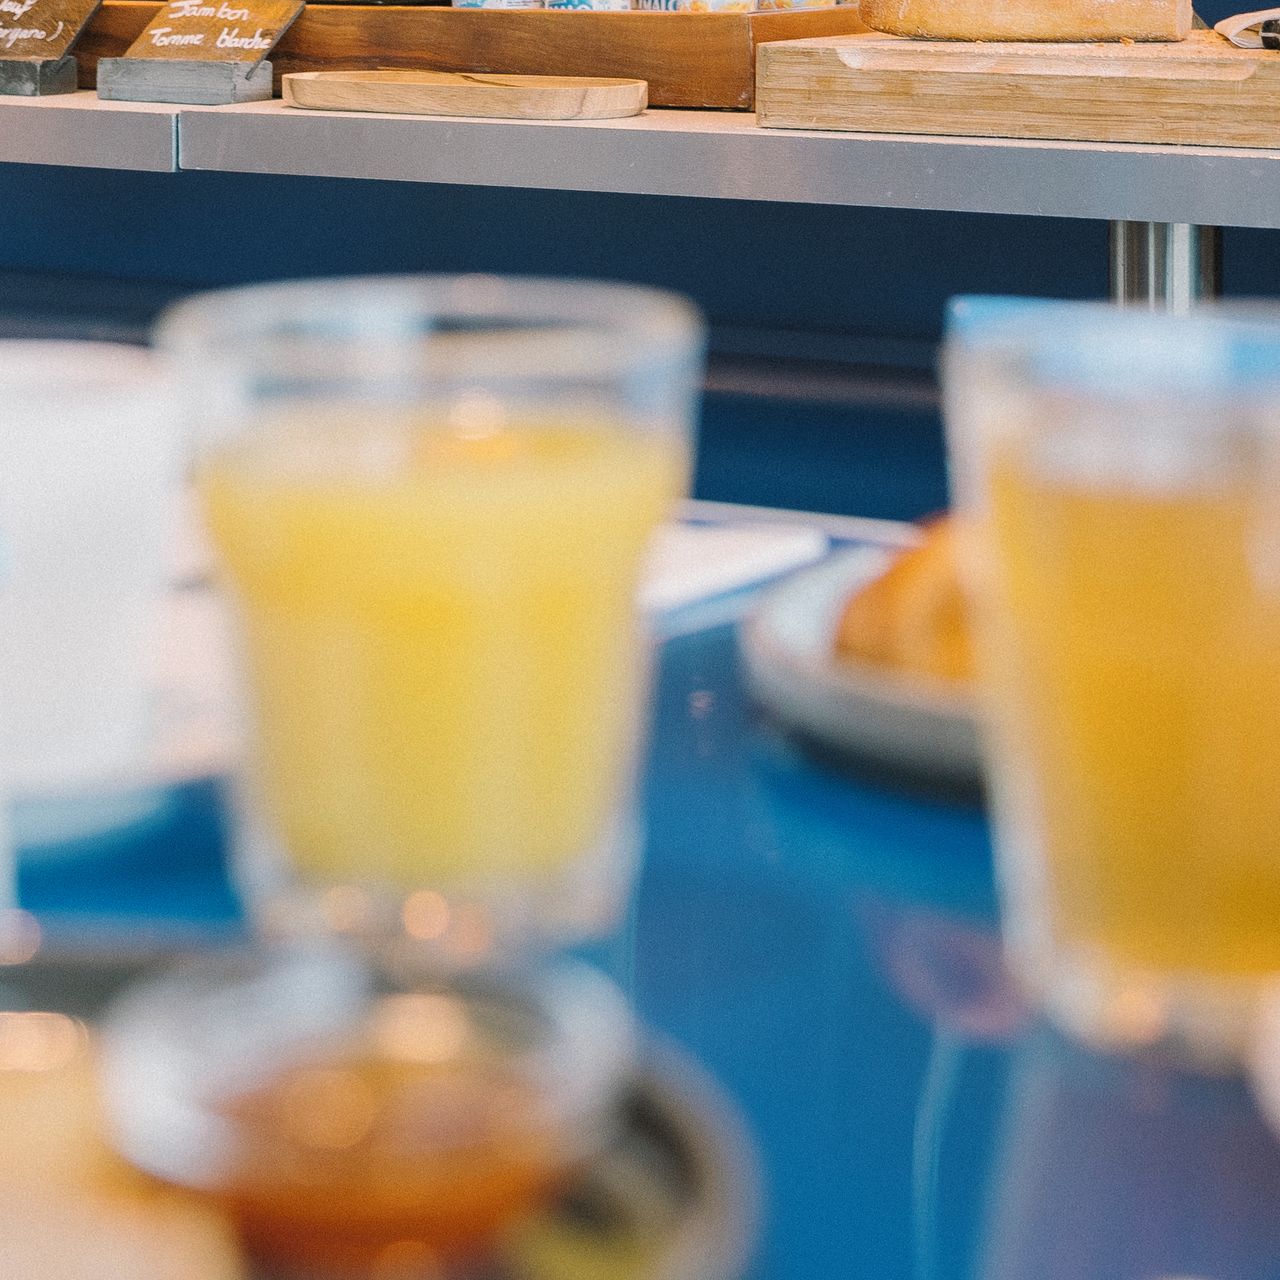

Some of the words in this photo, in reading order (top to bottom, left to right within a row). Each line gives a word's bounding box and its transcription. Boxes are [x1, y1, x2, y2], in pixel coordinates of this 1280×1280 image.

[169, 0, 249, 20] Jambon
[150, 27, 205, 46] Tomme
[216, 27, 272, 49] blanche
